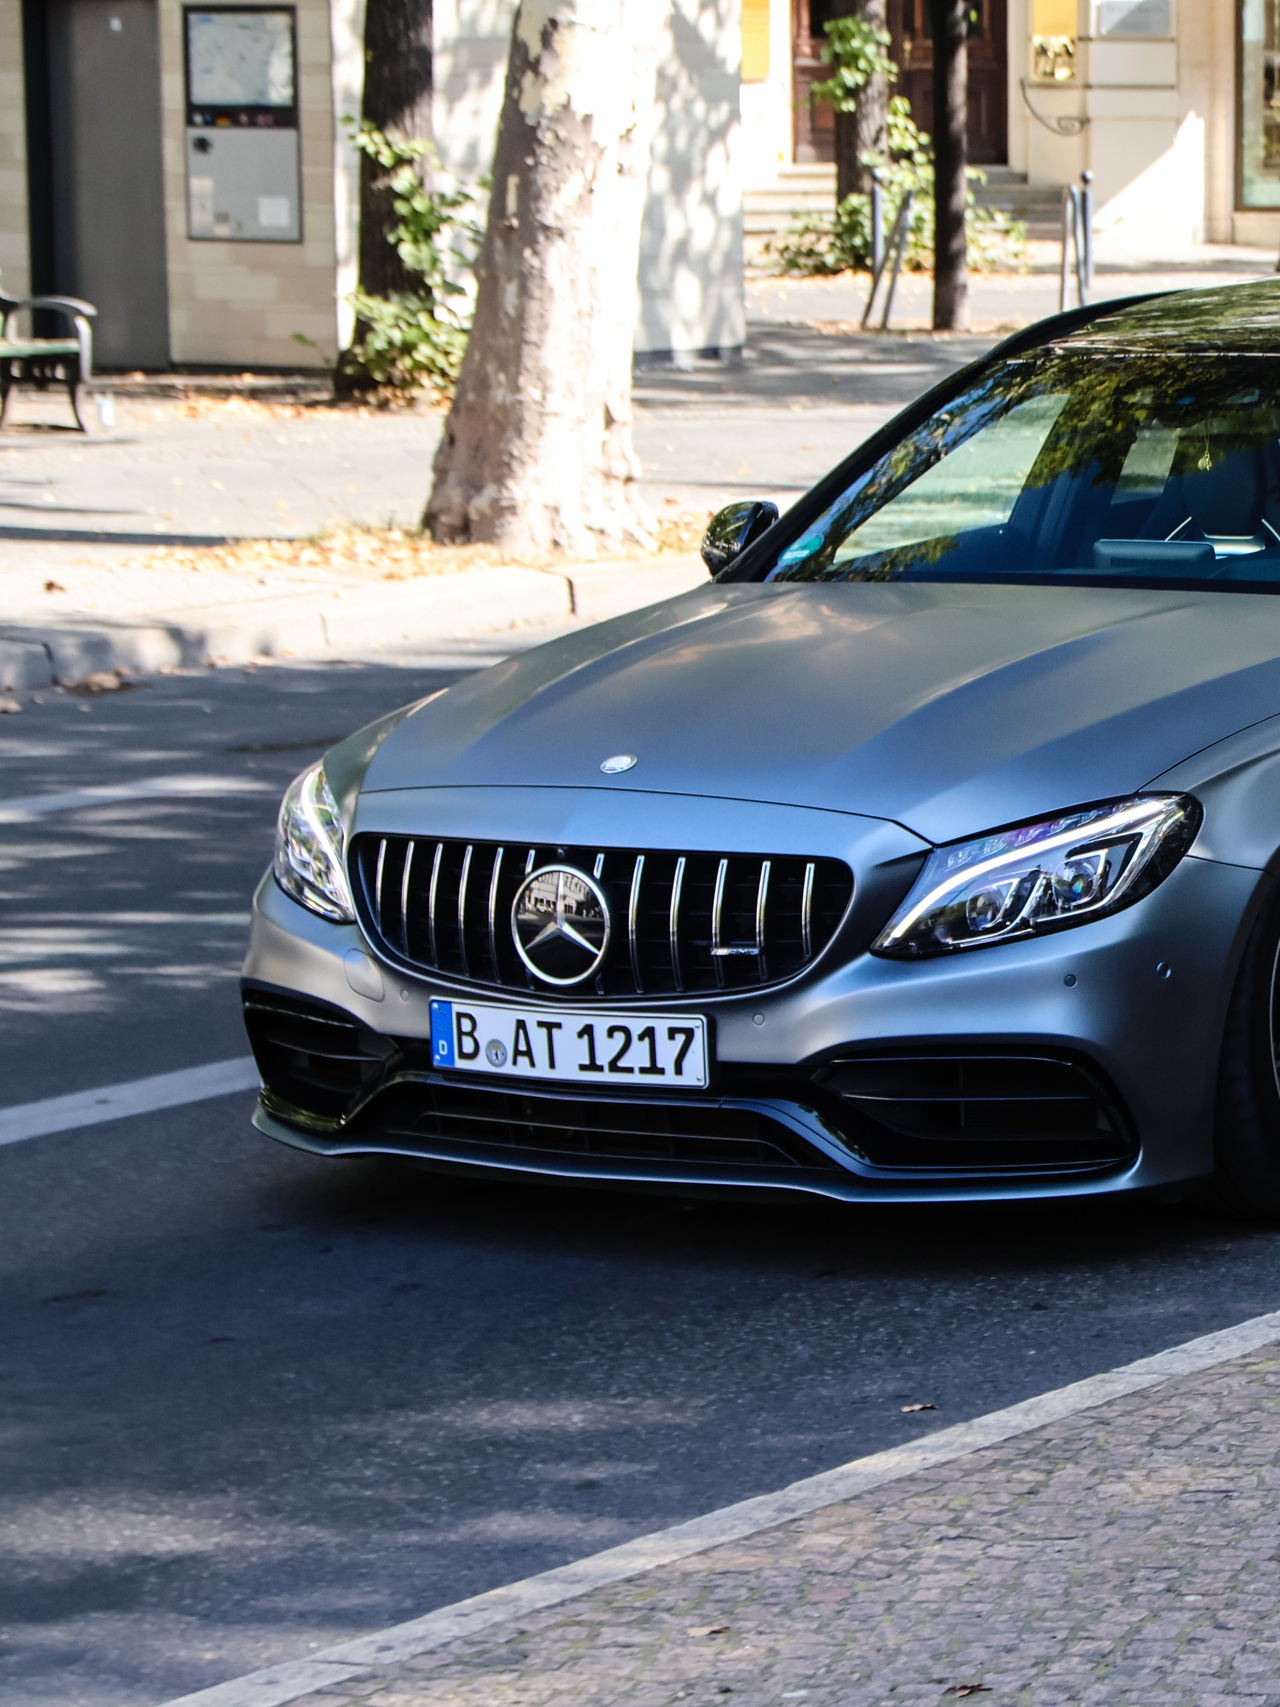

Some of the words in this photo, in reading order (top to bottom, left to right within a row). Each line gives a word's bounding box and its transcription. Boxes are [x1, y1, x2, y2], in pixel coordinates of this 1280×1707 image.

[728, 948, 759, 956] AMG
[438, 1040, 448, 1055] D
[455, 1011, 480, 1060] B
[511, 1018, 563, 1070] AT
[576, 1023, 695, 1076] 1217
